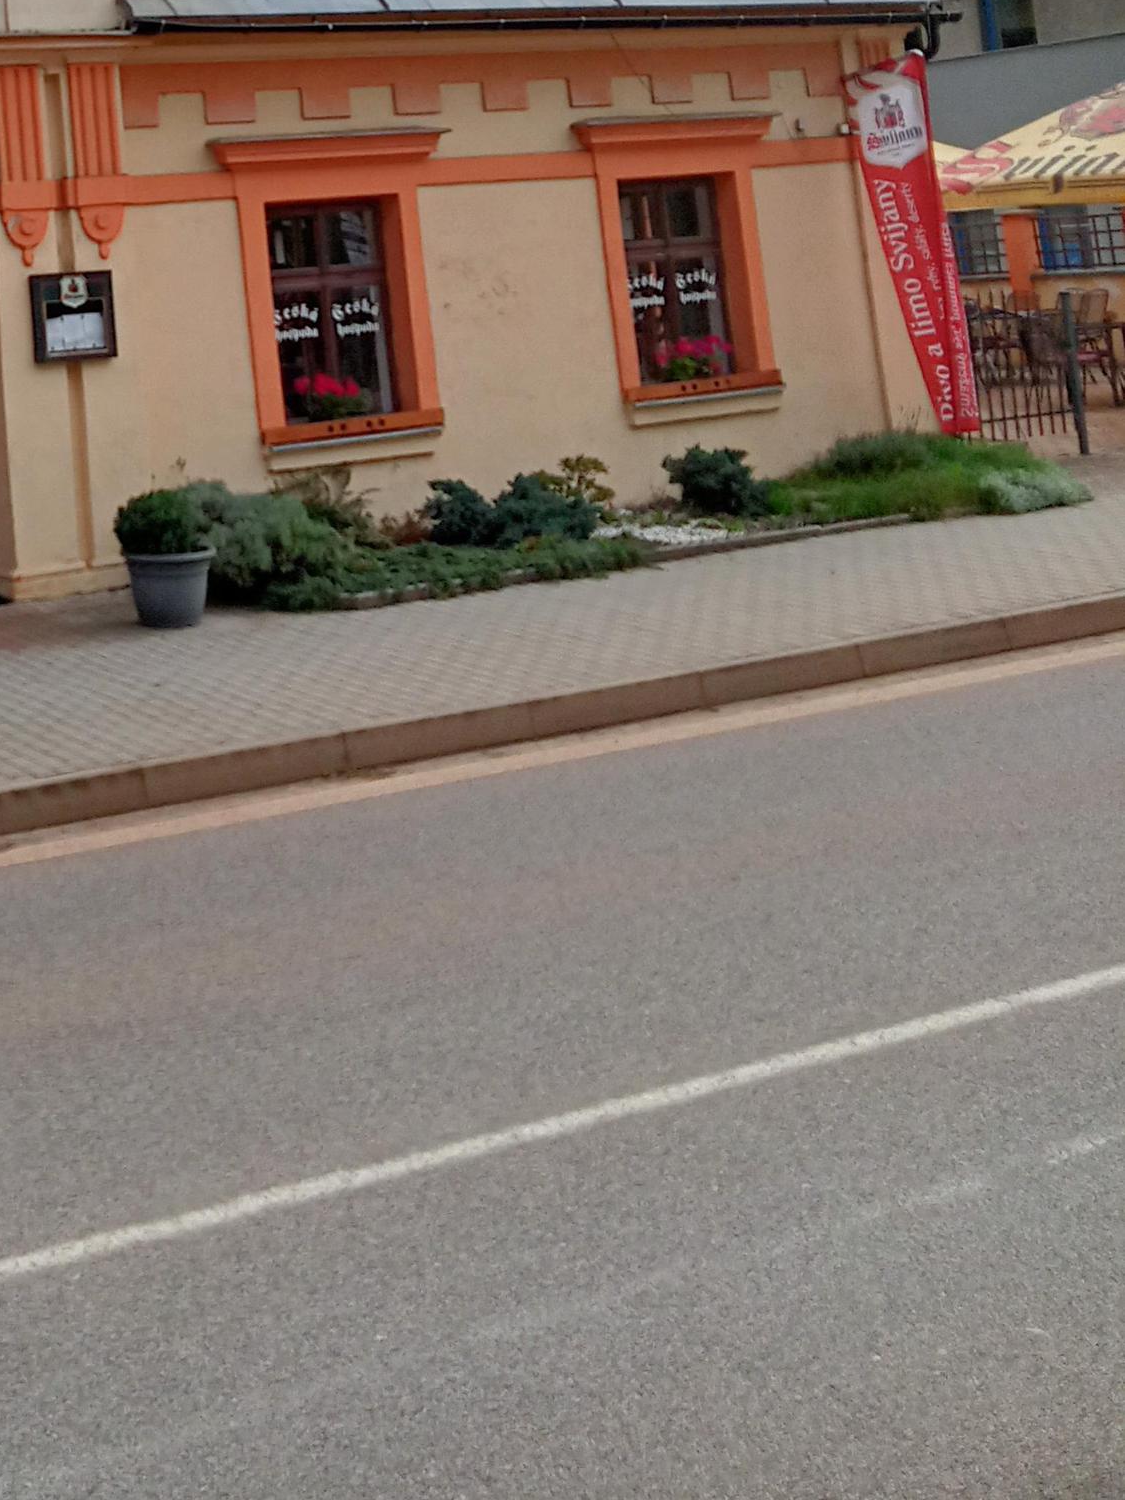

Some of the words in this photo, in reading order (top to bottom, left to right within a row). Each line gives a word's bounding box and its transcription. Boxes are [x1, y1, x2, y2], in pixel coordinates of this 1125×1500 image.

[874, 180, 915, 272] Svijany
[904, 278, 936, 337] limo
[927, 342, 944, 357] a
